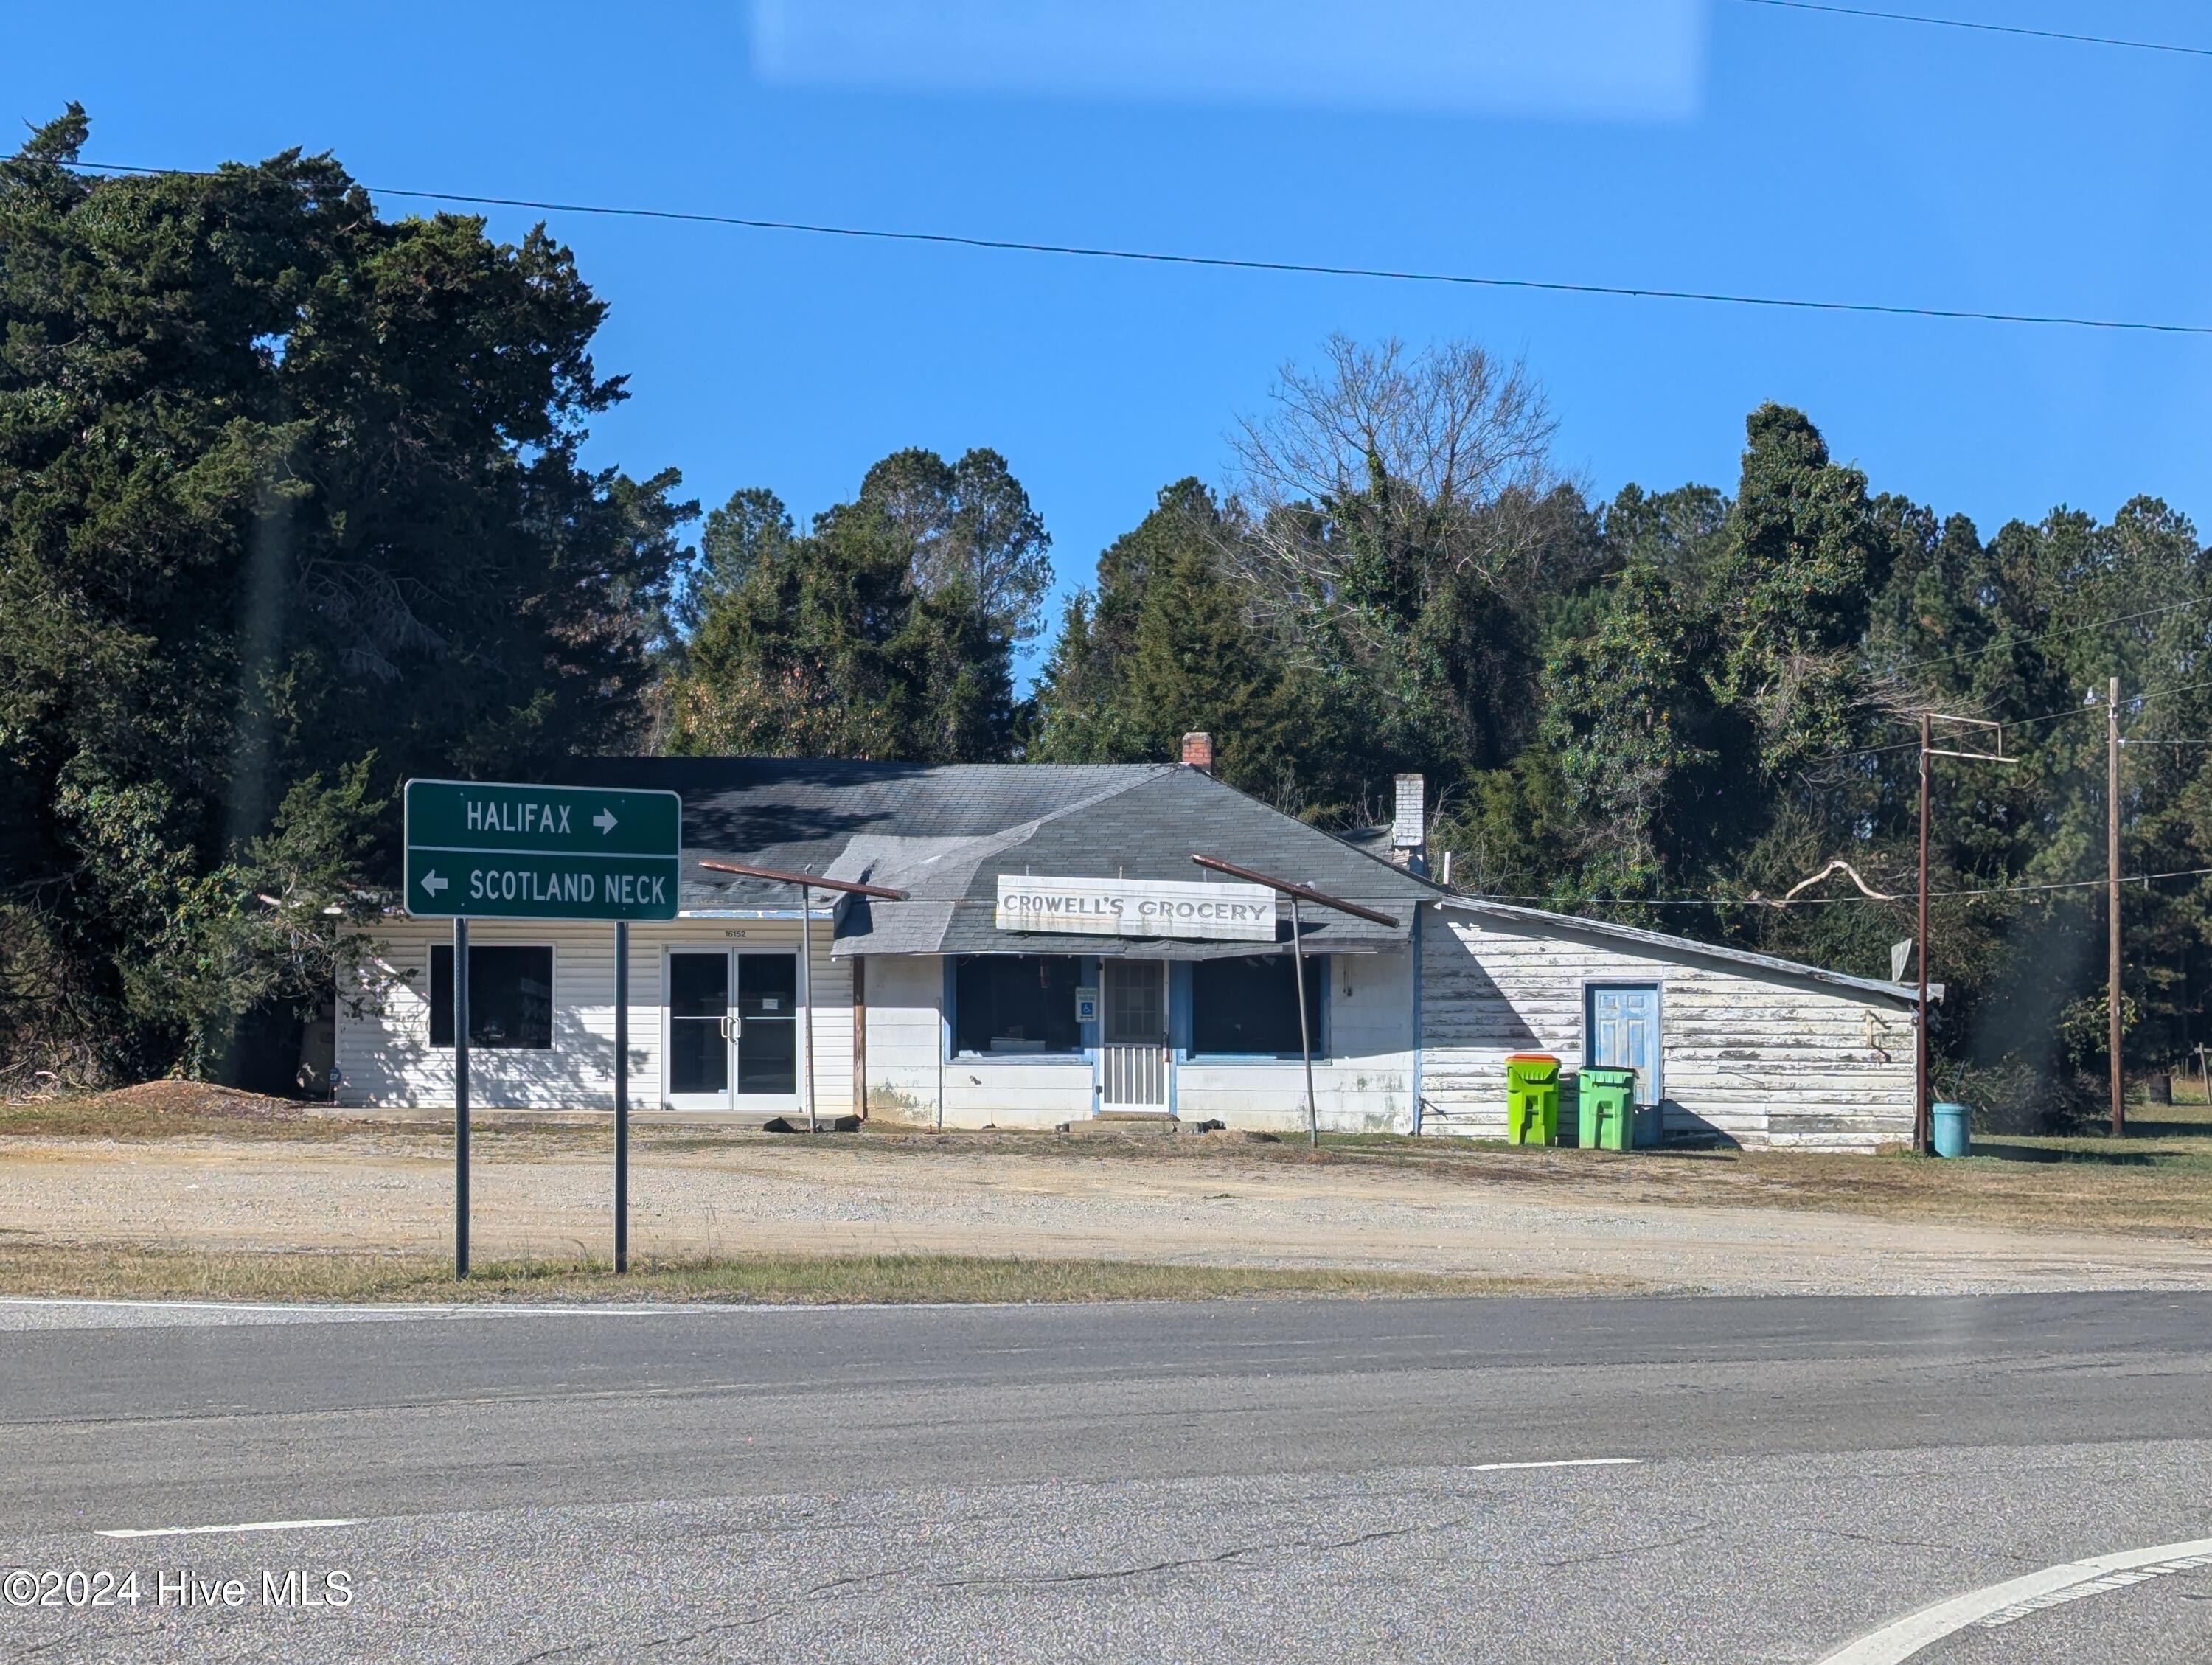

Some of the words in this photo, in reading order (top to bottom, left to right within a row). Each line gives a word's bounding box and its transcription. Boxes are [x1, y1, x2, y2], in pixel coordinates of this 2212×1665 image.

[467, 801, 571, 834] HALIFAX
[470, 869, 595, 902] SCOTLAND
[605, 875, 666, 905] NECK
[1003, 894, 1125, 916] CROWELL'S
[1138, 900, 1267, 921] GROCERY
